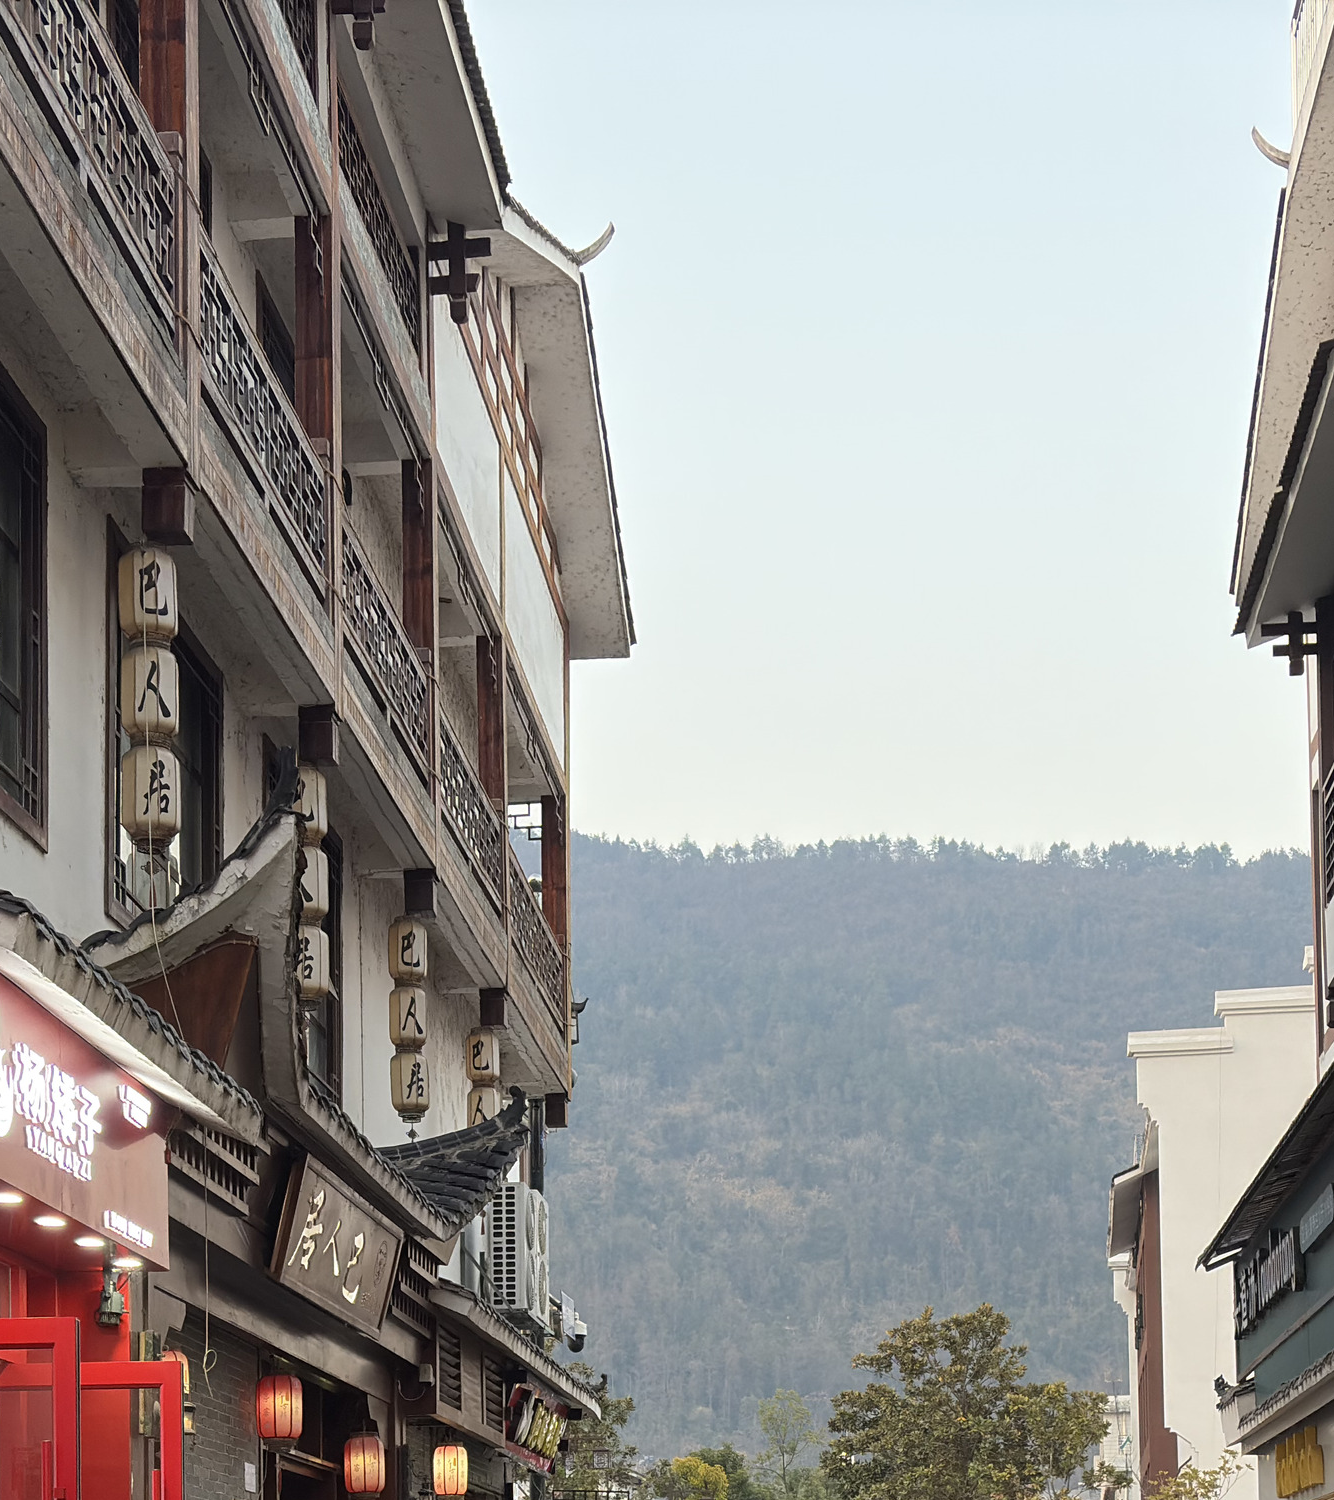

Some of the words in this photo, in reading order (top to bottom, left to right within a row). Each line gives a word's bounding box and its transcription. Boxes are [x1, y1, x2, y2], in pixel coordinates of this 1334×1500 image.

[137, 561, 172, 817] 巴人居
[400, 932, 425, 1099] 巴人居
